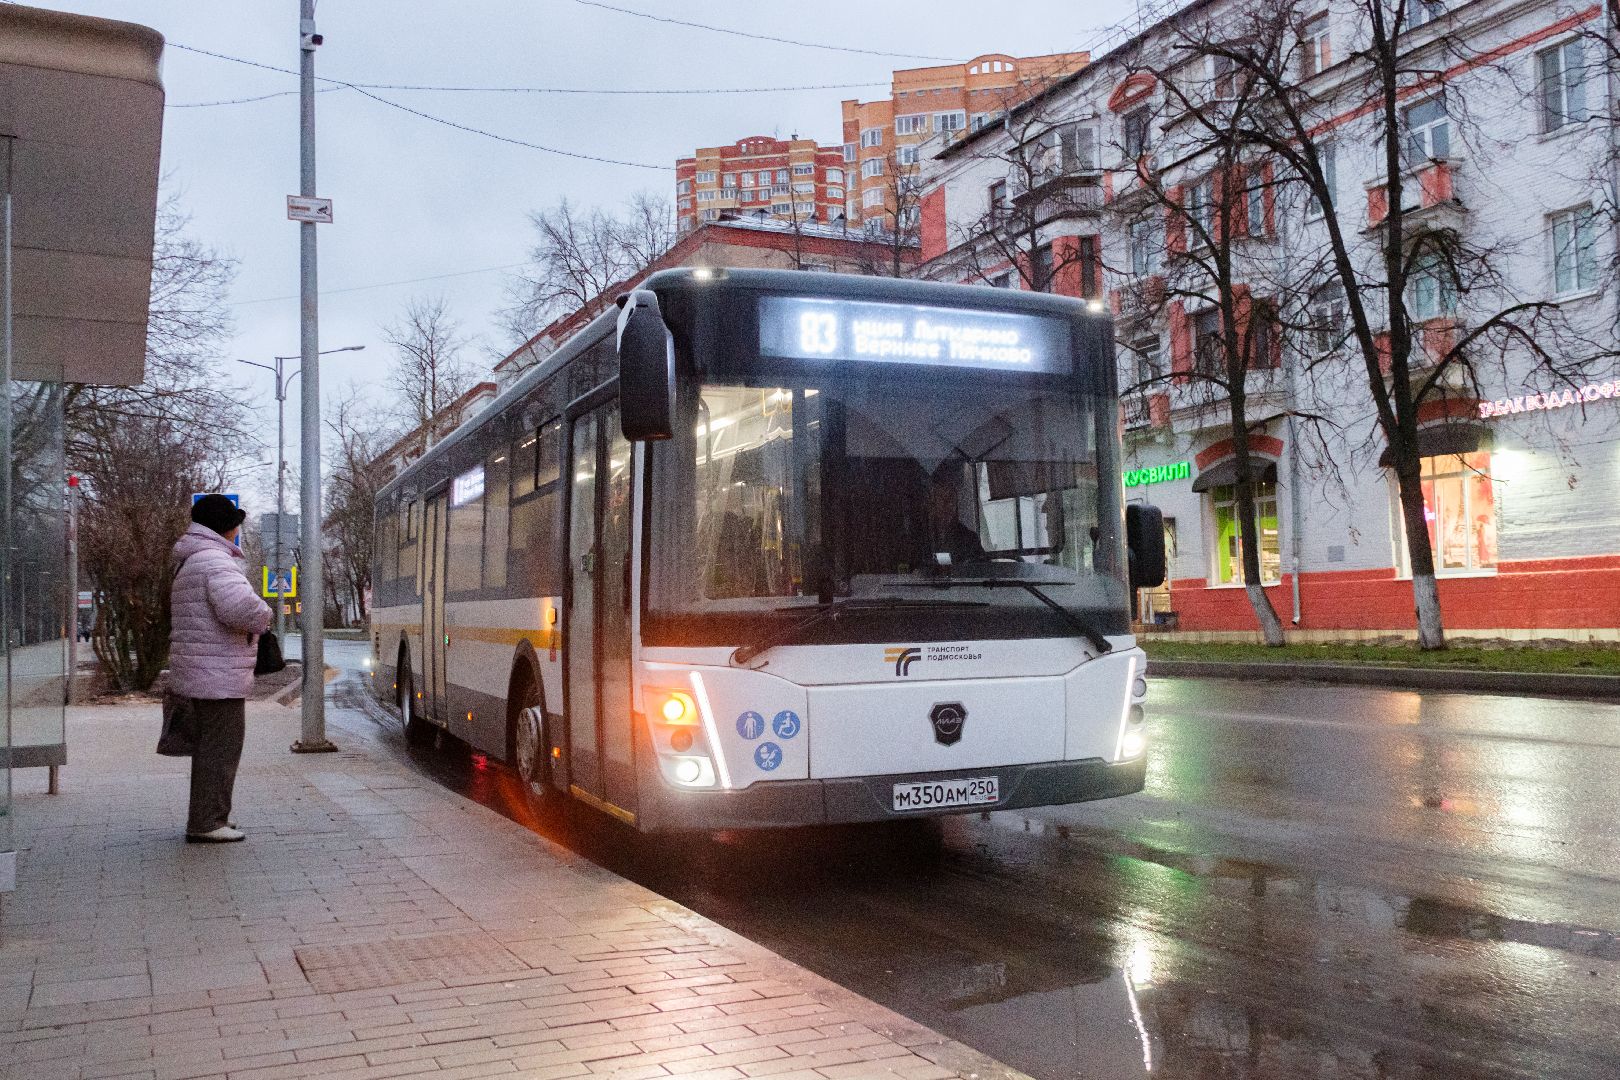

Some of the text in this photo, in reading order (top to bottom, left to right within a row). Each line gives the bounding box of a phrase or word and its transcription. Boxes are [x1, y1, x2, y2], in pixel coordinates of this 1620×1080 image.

[800, 311, 837, 353] 83
[855, 335, 941, 358] Верхнее
[1479, 397, 1526, 418] ТАБАК
[1525, 390, 1575, 410] ВОДА
[927, 653, 982, 661] ПОДМОСКОВЬЯ
[899, 780, 994, 806] М350АМ 250
